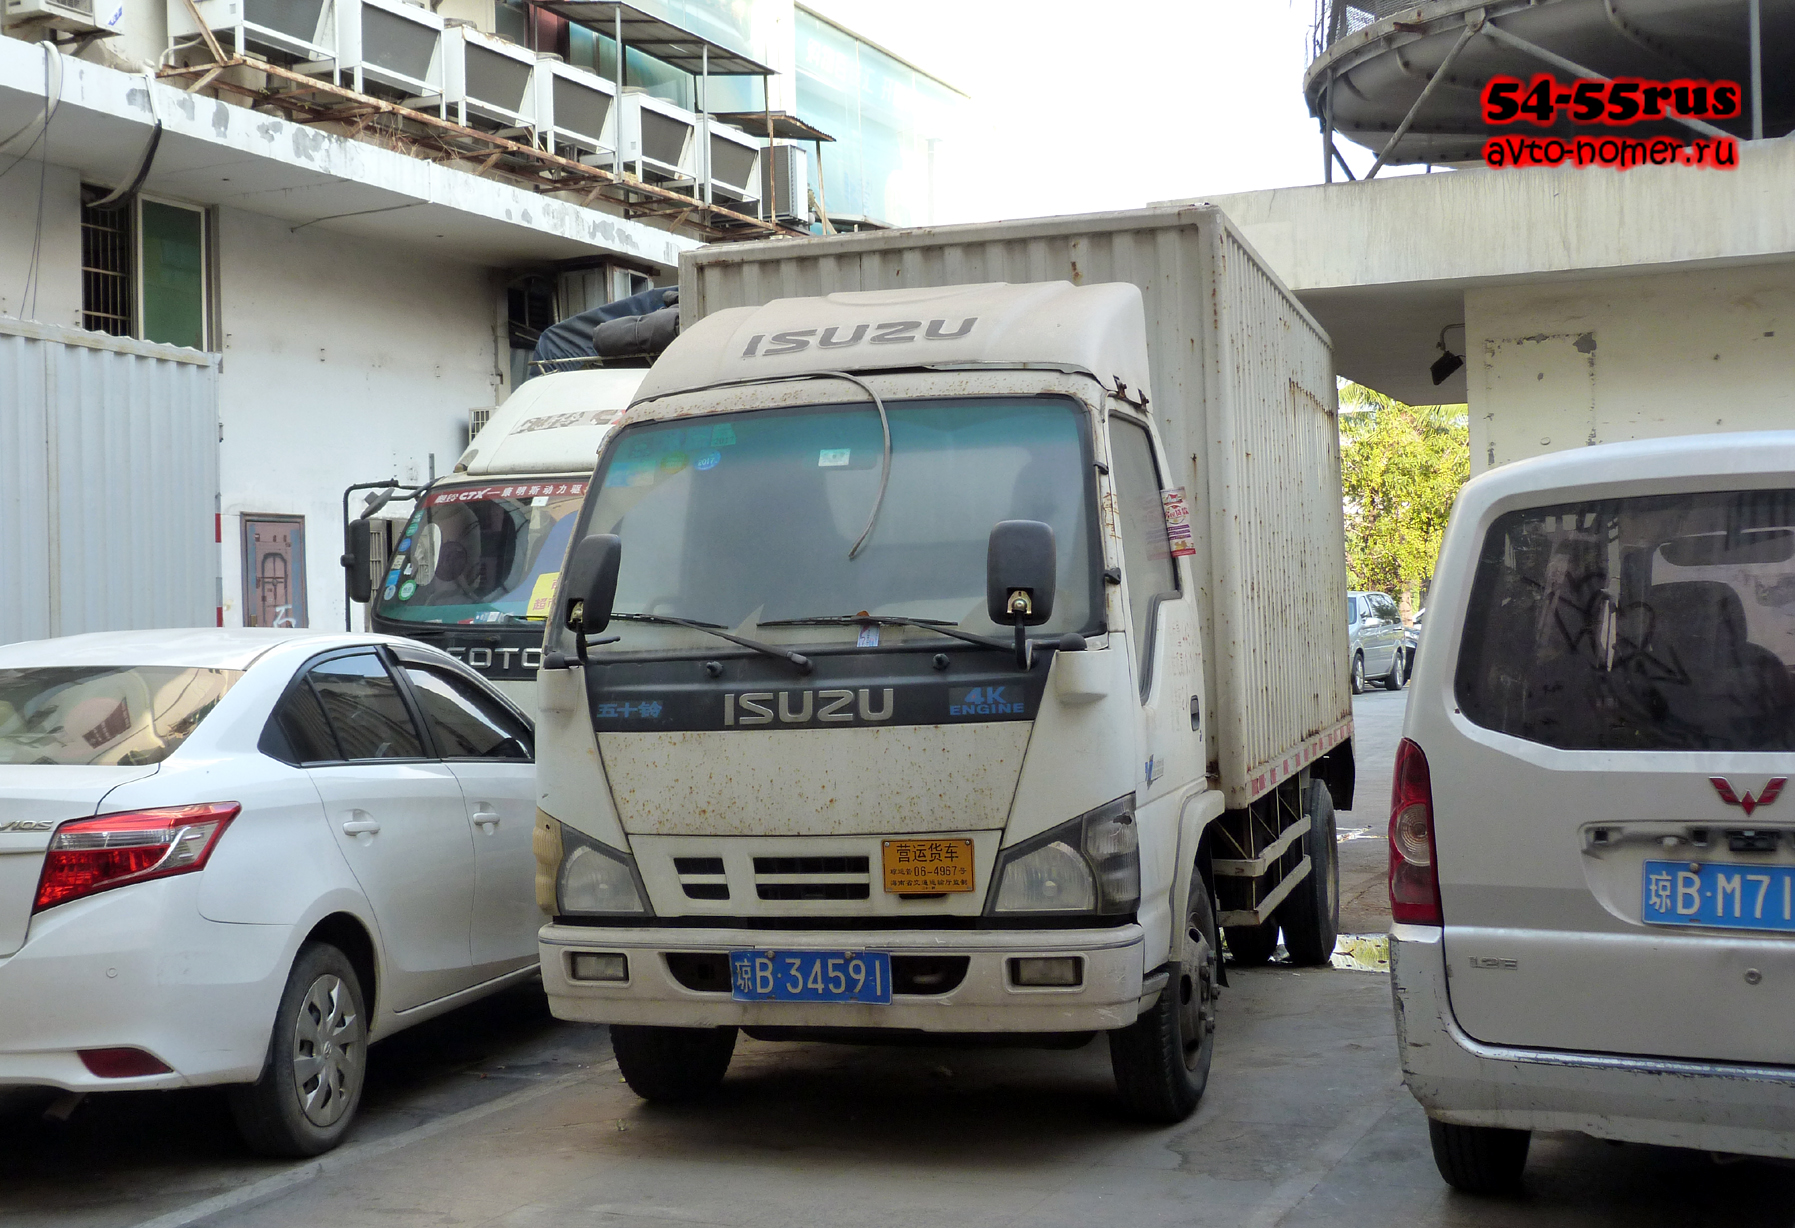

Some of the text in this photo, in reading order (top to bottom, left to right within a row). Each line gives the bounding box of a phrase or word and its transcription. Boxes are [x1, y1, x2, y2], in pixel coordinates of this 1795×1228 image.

[741, 317, 979, 358] ISUZU
[964, 686, 1006, 705] 4K
[597, 701, 663, 719] 五十铃
[723, 688, 894, 726] ISUZU
[949, 702, 1026, 716] ENGINE
[896, 843, 959, 863] 营运货车
